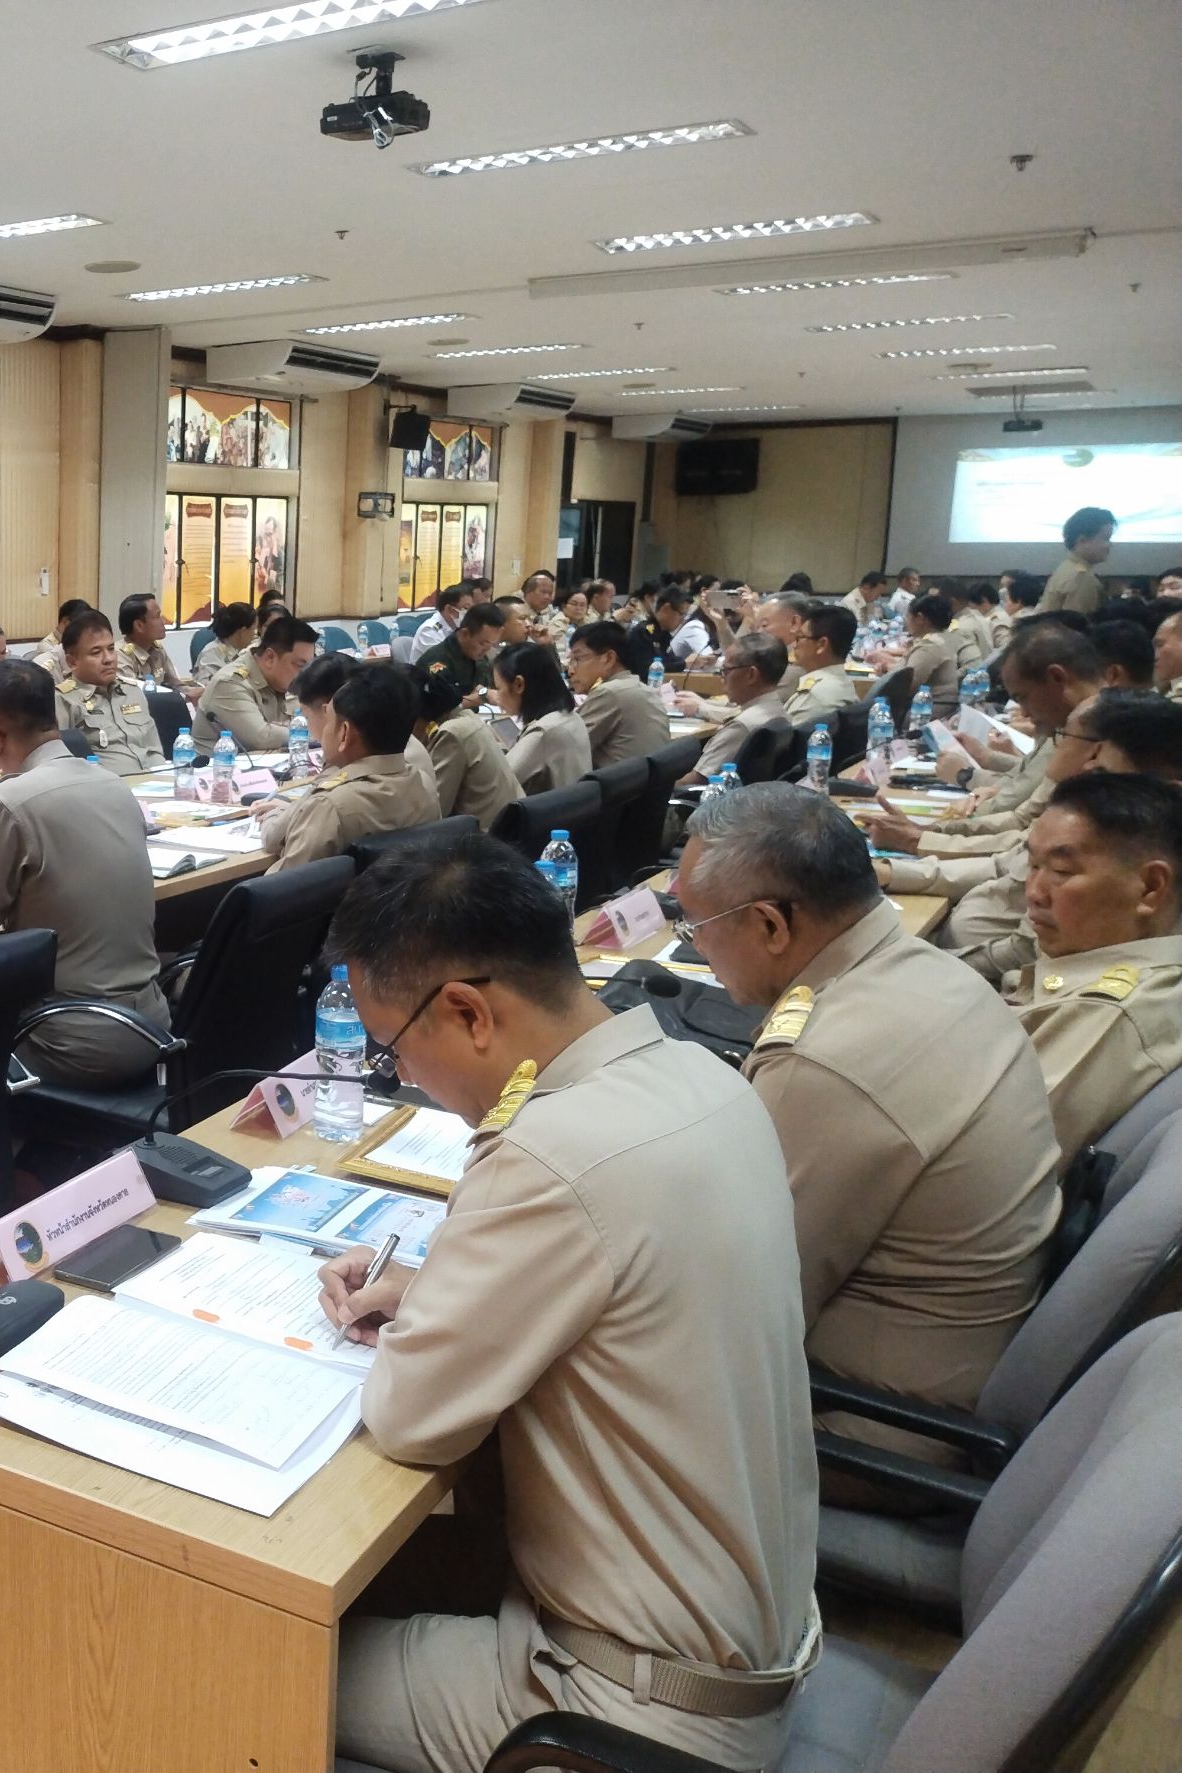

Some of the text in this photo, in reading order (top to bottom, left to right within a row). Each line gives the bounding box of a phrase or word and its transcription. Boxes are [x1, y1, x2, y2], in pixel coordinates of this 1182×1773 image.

[46, 1187, 130, 1242] หัวหน้าสำนักงานจังหวัดหนองคาย
